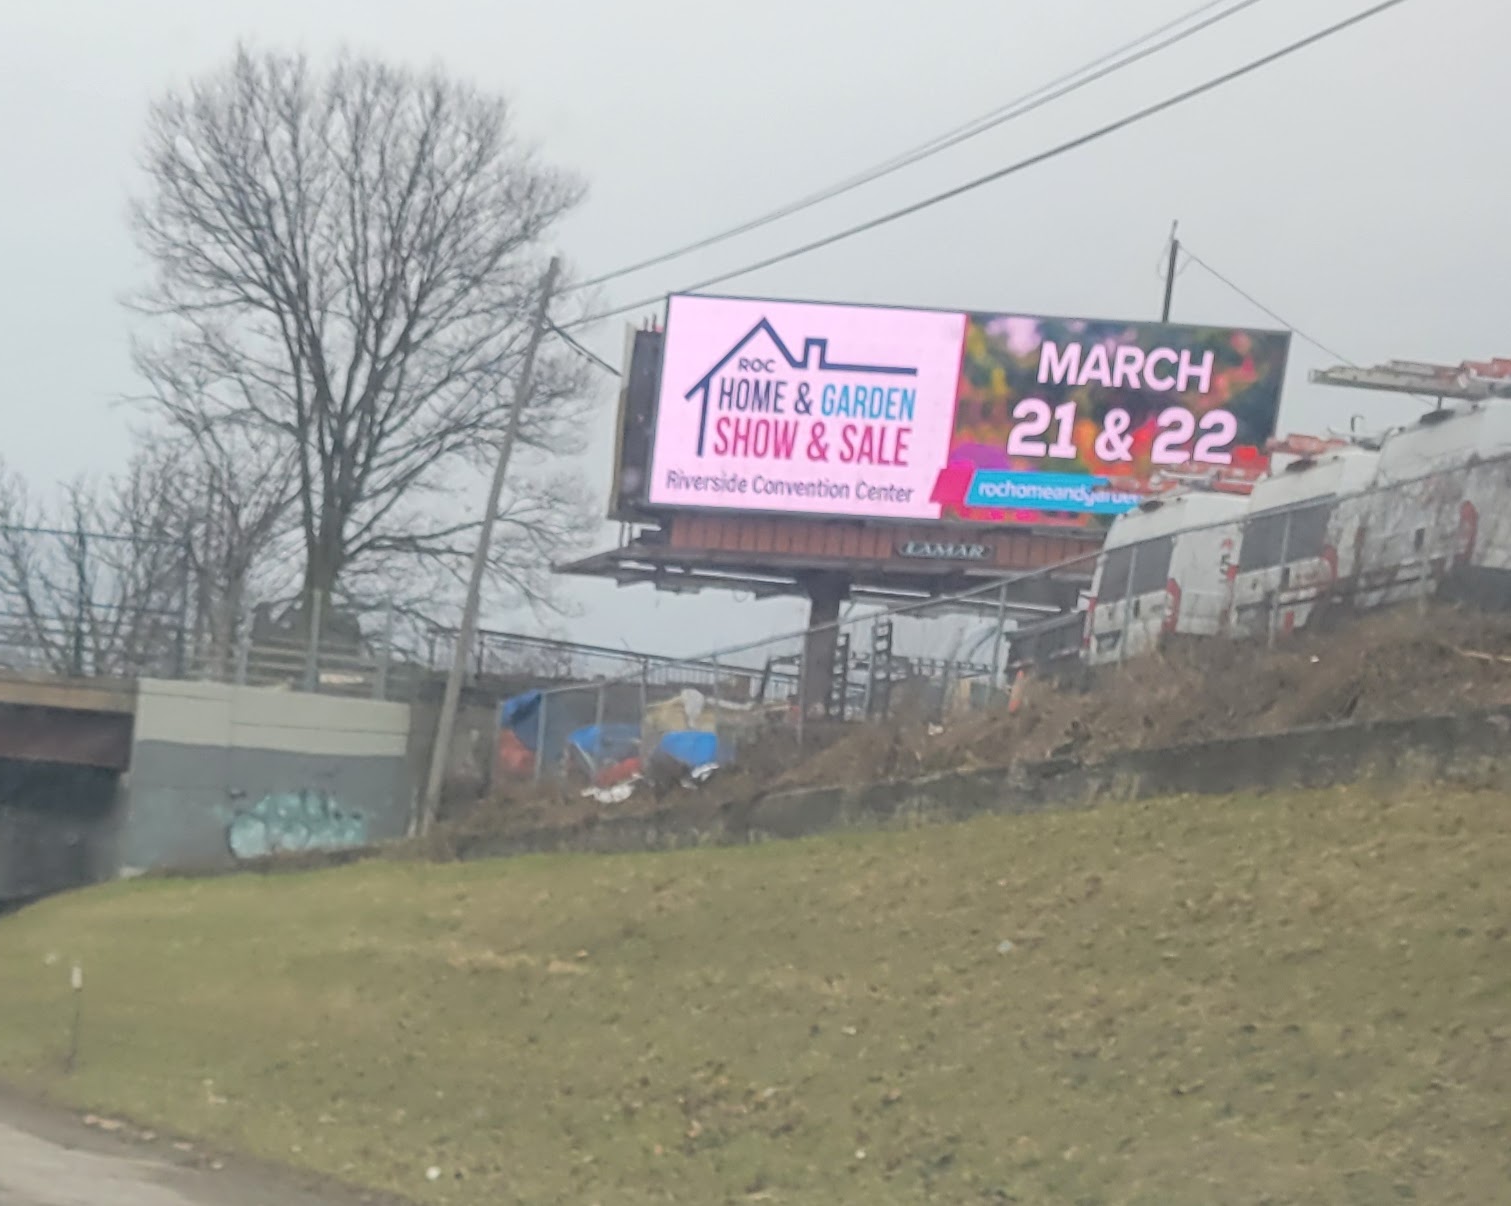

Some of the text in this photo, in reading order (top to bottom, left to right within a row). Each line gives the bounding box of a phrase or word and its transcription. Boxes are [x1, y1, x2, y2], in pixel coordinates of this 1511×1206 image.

[738, 358, 776, 373] ROC
[1038, 341, 1214, 393] MARCH
[719, 377, 916, 421] HOME & GARDEN
[714, 416, 912, 466] SHOW & SALE
[1007, 398, 1238, 465] 21 & 22
[666, 470, 915, 504] Riverside Convention Center
[906, 541, 985, 557] LAMAR
